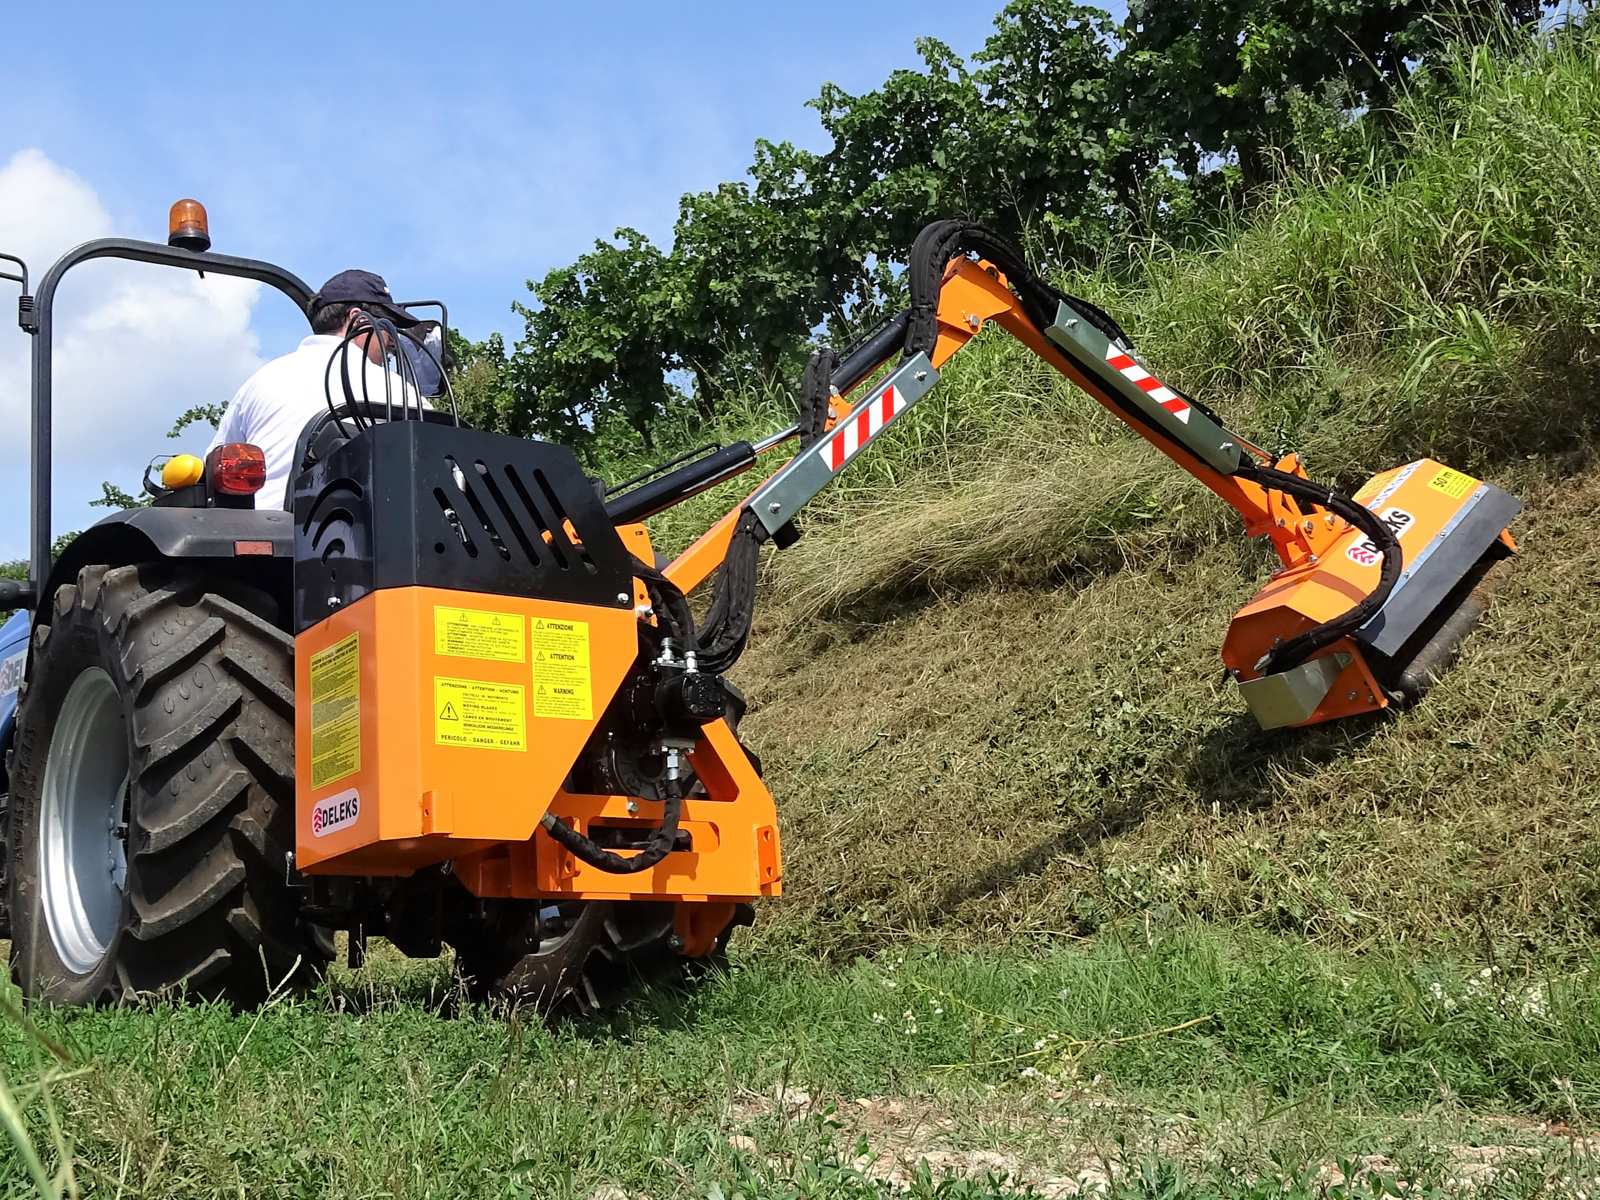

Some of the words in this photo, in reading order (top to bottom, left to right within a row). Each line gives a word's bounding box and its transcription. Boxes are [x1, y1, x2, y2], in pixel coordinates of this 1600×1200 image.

[1433, 477, 1448, 488] 50
[547, 623, 574, 631] ATTENZIONE
[322, 796, 358, 828] DELEKS
